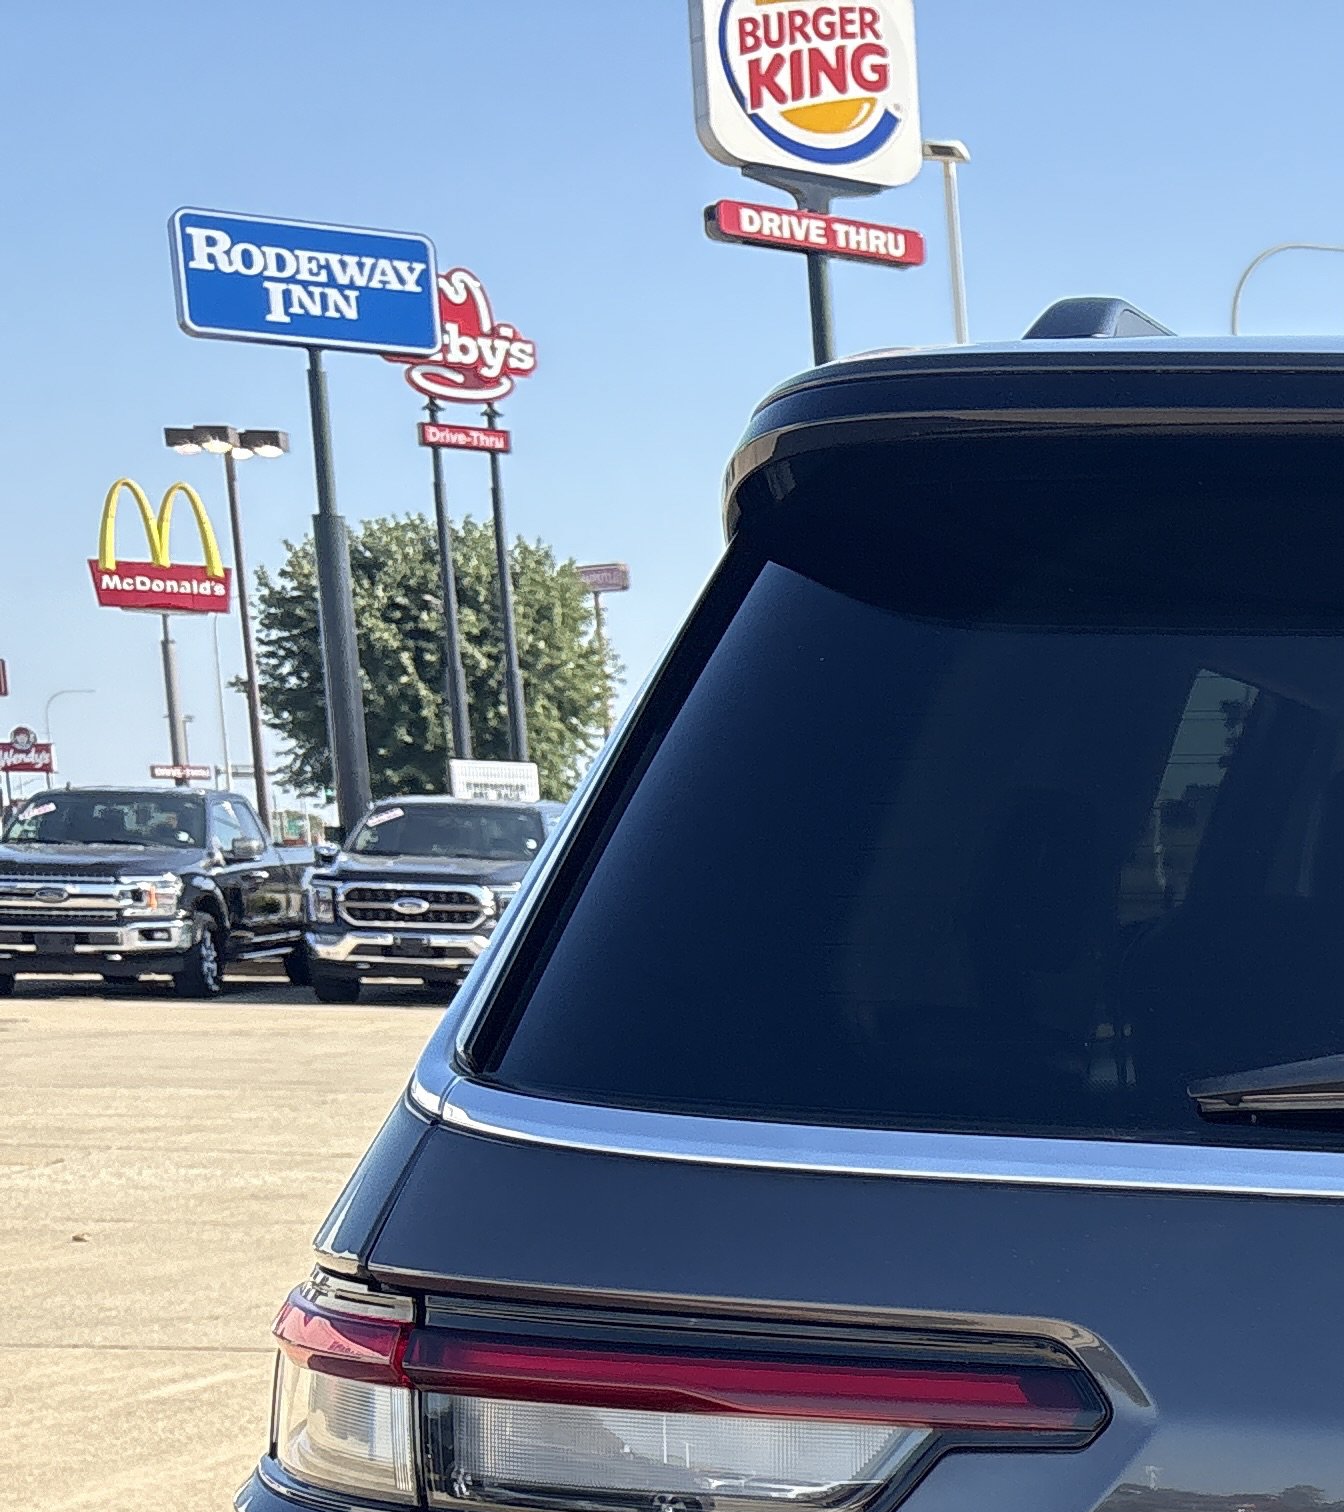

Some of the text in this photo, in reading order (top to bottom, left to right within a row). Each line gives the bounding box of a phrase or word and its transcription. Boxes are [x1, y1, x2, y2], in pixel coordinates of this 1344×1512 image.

[737, 7, 882, 56] BURGER
[747, 43, 890, 110] KING
[739, 208, 906, 257] DRIVE THRU
[185, 226, 427, 293] RODEWAY
[264, 282, 360, 323] INN
[429, 322, 535, 378] by's
[425, 425, 505, 449] Drive-Thru
[100, 573, 226, 597] McDonald's
